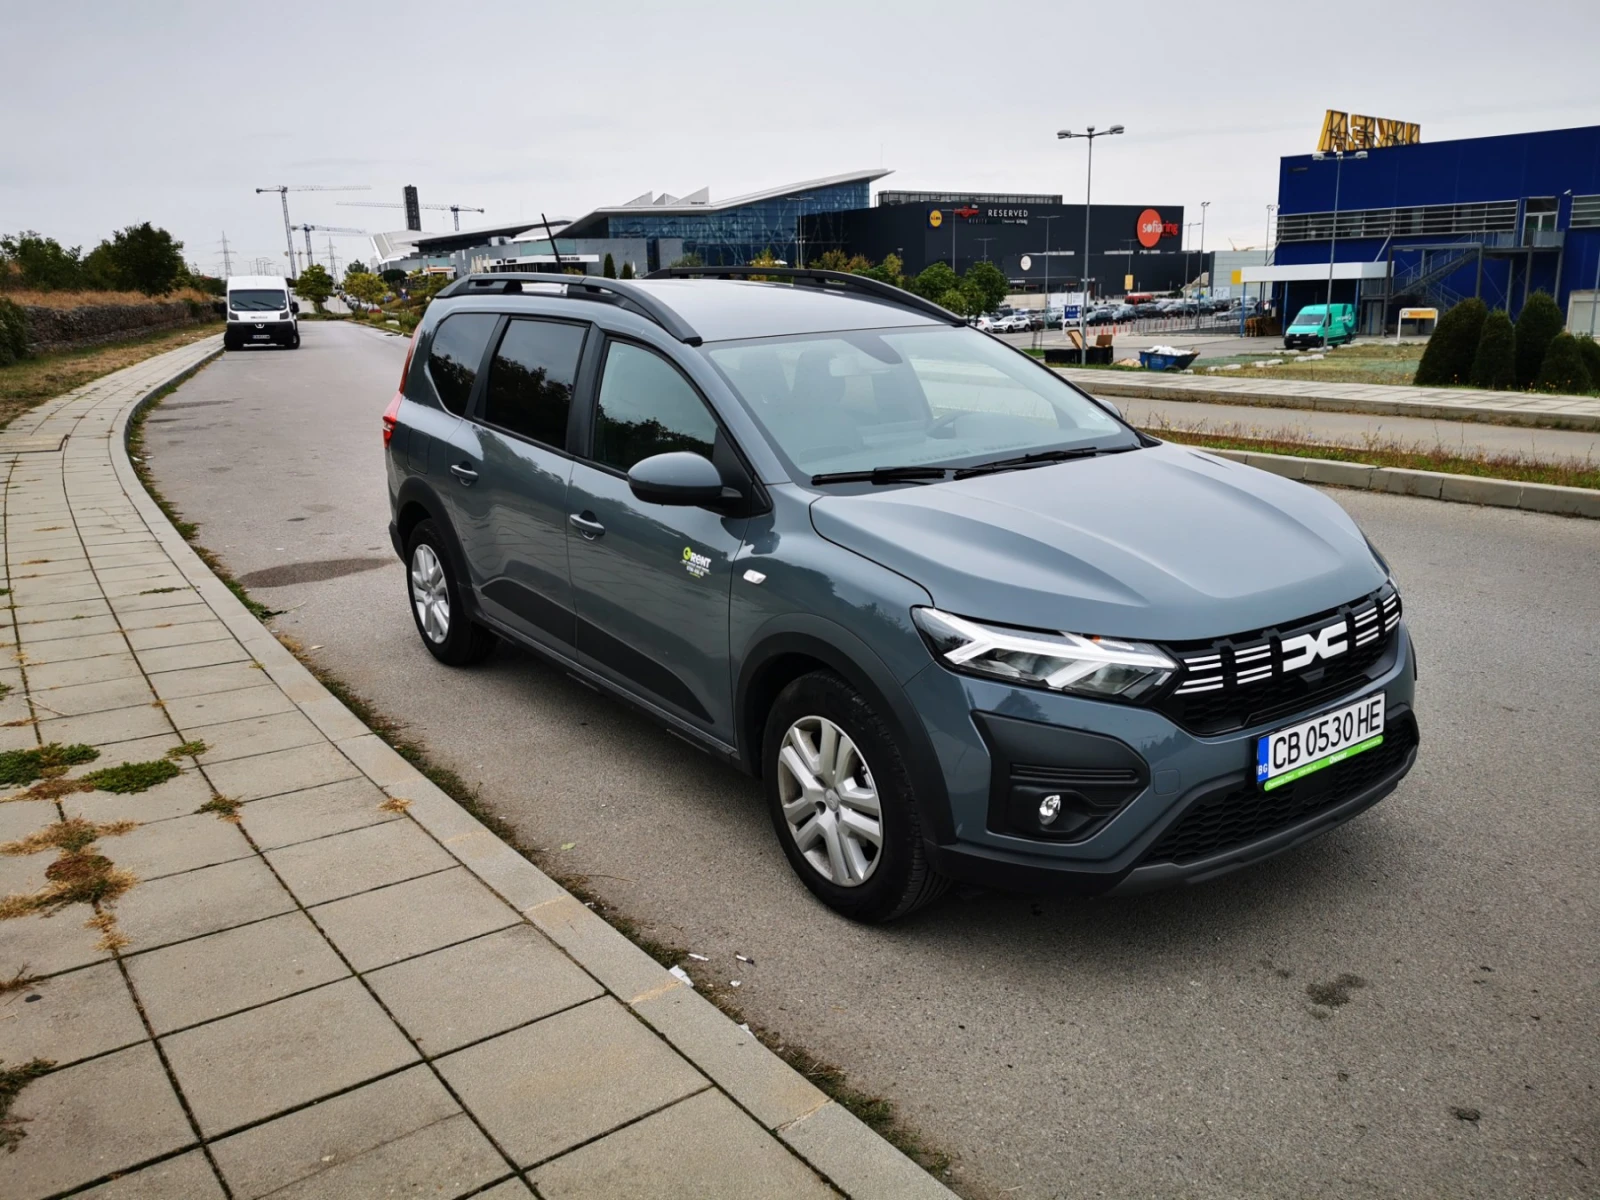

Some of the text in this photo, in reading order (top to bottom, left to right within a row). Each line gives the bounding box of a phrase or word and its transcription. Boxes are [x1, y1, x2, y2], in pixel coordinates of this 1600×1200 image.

[987, 209, 1028, 218] RESERVED
[1273, 699, 1381, 769] CB 0530 HE
[1258, 763, 1267, 775] BG
